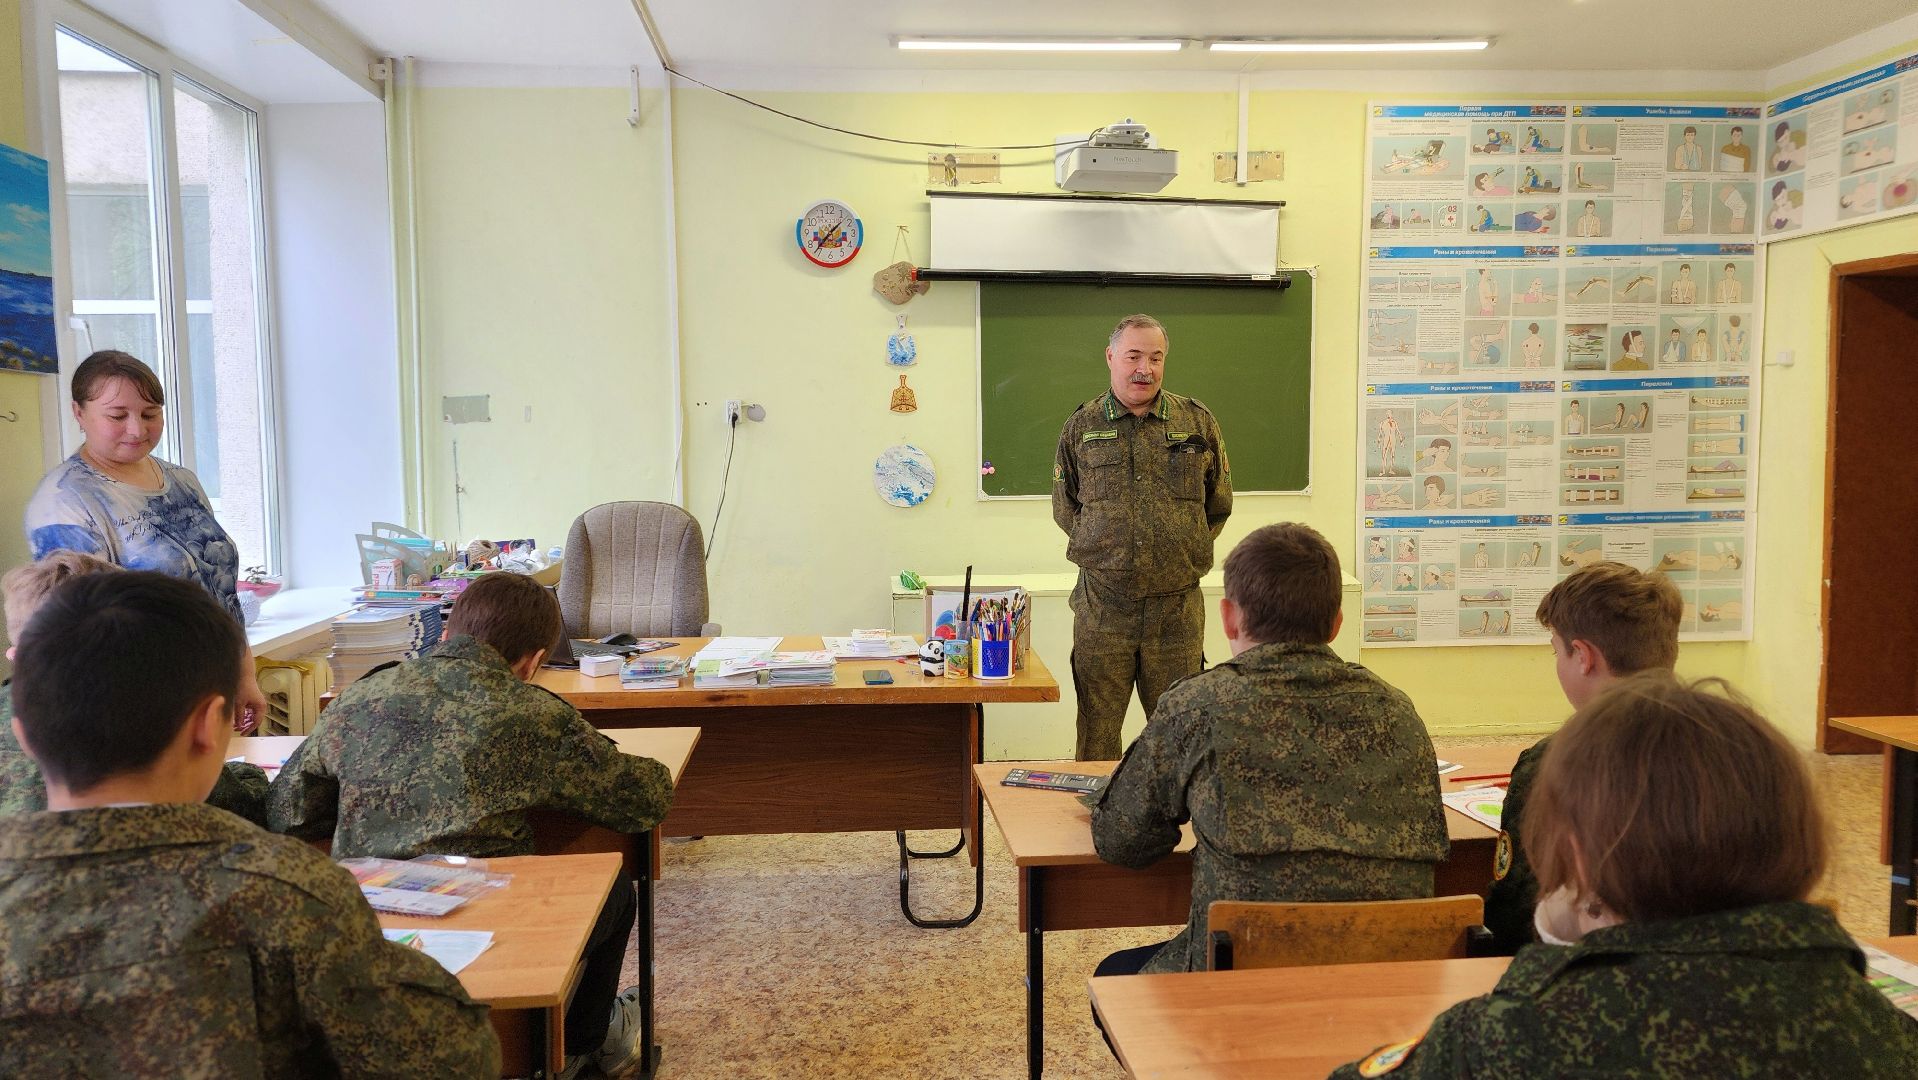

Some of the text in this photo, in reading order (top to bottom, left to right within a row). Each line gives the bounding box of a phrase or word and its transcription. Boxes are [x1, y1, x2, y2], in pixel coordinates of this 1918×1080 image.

[825, 206, 834, 214] 12
[1447, 205, 1457, 213] 03
[839, 210, 843, 218] 1
[807, 218, 816, 226] 10
[847, 219, 852, 227] 2
[851, 229, 855, 237] 3
[807, 240, 814, 249] 8
[817, 248, 823, 258] 7
[828, 251, 833, 259] 6
[840, 248, 844, 257] 5
[1455, 249, 1497, 257] кровотечения
